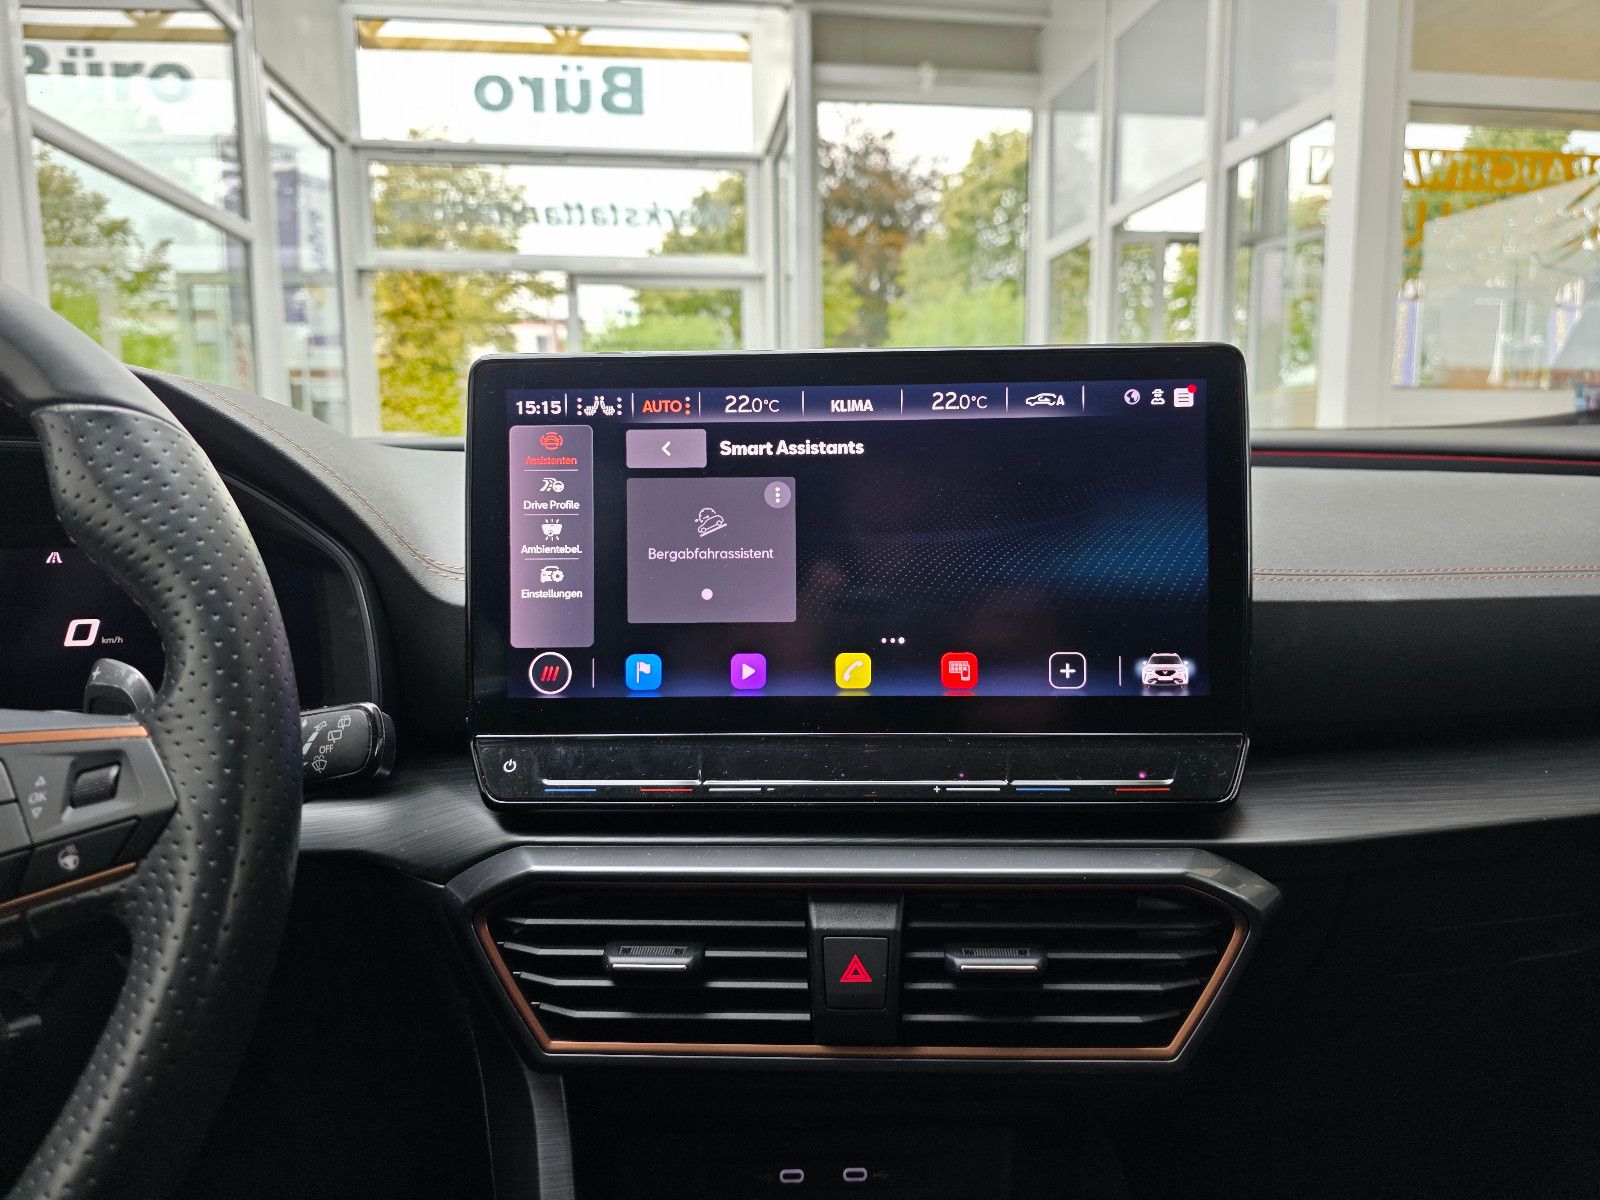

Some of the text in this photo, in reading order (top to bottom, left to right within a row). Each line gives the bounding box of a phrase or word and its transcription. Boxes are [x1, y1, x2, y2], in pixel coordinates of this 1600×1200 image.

[516, 400, 562, 415] 15:15
[642, 400, 683, 413] AUTO
[830, 399, 873, 413] KLIMA
[719, 439, 865, 456] Smart Assistants
[524, 456, 577, 465] Assistenten
[523, 500, 580, 510] Drive Profile
[521, 544, 583, 554] Ambientebel.
[648, 547, 775, 562] Bergabfahrassistent
[521, 588, 583, 600] Einstellungen
[63, 618, 124, 647] 0 km/h
[319, 744, 334, 754] OFF
